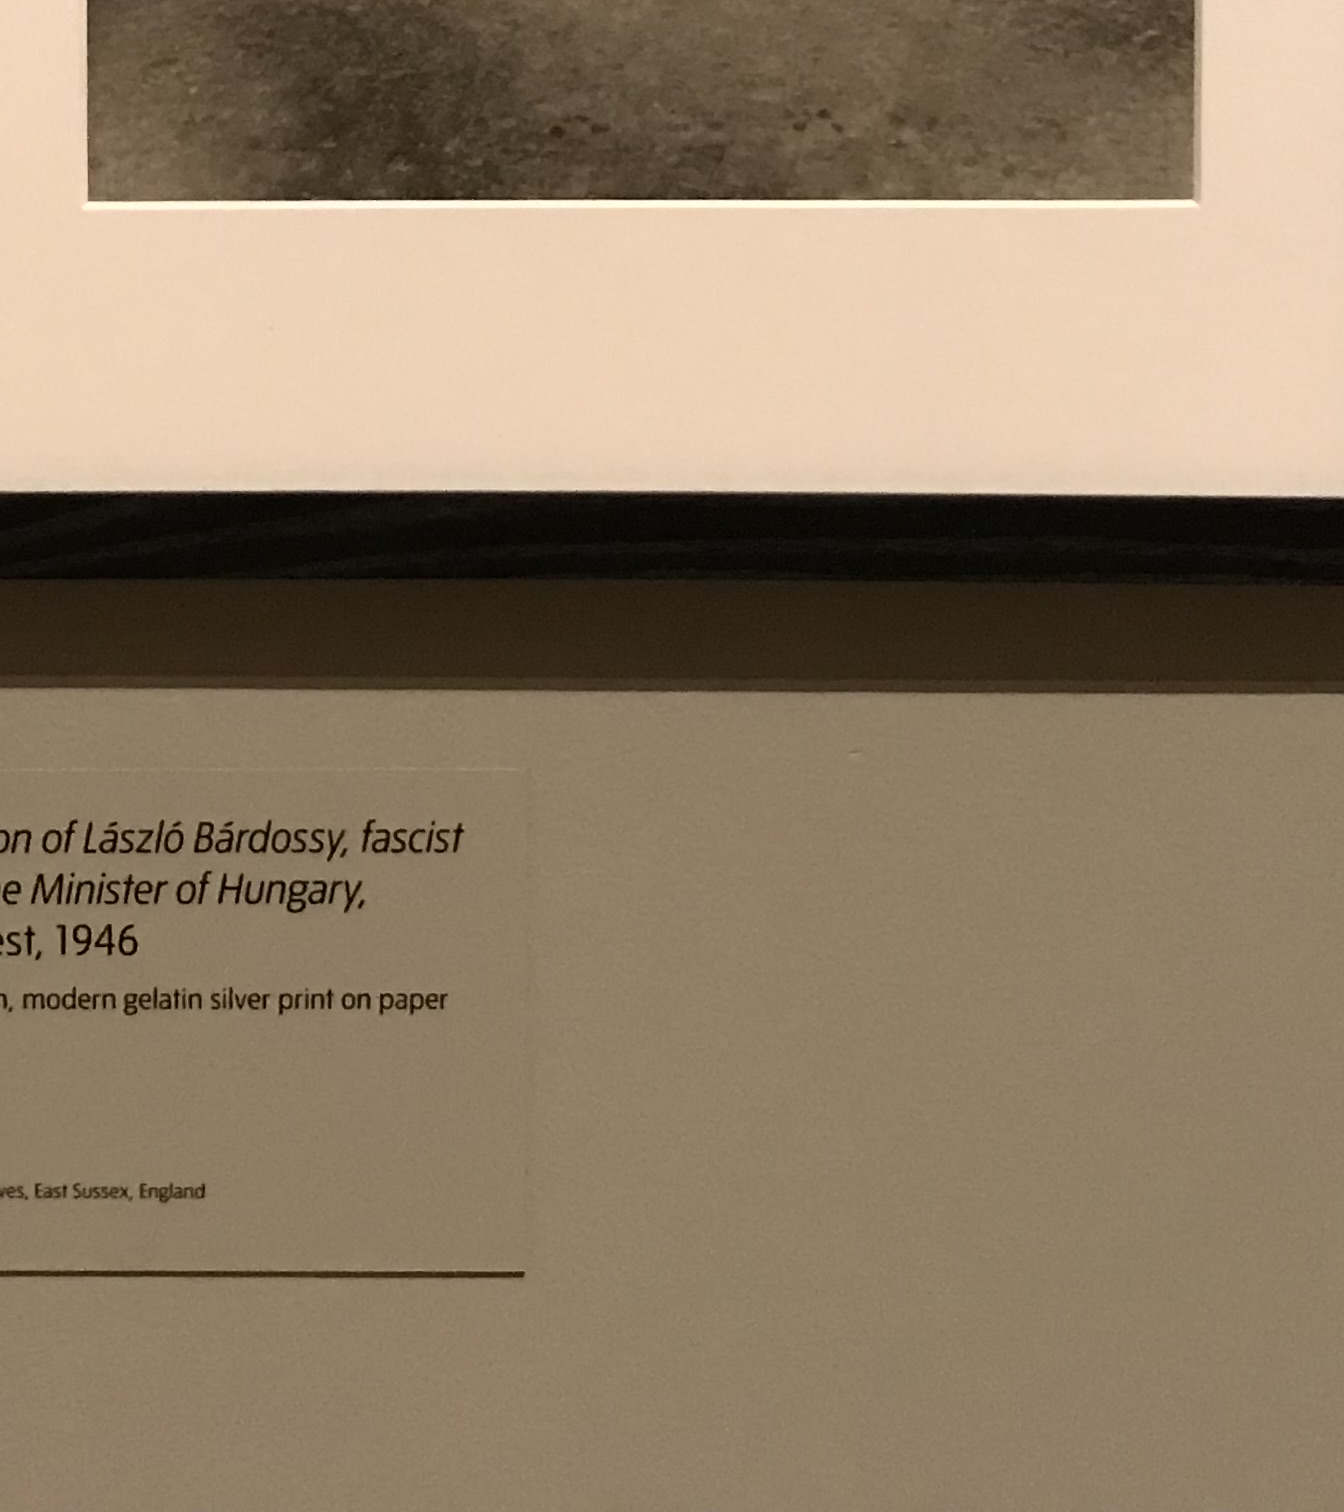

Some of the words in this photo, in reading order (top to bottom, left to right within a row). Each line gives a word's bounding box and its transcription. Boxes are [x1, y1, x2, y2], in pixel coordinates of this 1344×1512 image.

[41, 818, 79, 855] of
[82, 818, 185, 855] László
[193, 819, 348, 863] Bárdossy,
[361, 818, 466, 855] fascist
[30, 871, 170, 906] Minister
[175, 870, 213, 906] of
[217, 872, 366, 914] Hungary,
[55, 923, 139, 957] 1946
[21, 985, 117, 1011] modern
[122, 985, 203, 1017] gelatin
[209, 986, 272, 1011] silver
[277, 987, 335, 1016] print
[340, 992, 372, 1011] on
[376, 992, 449, 1017] paper
[33, 1182, 69, 1201] East
[71, 1182, 134, 1203] Sussex,
[138, 1181, 207, 1205] England
